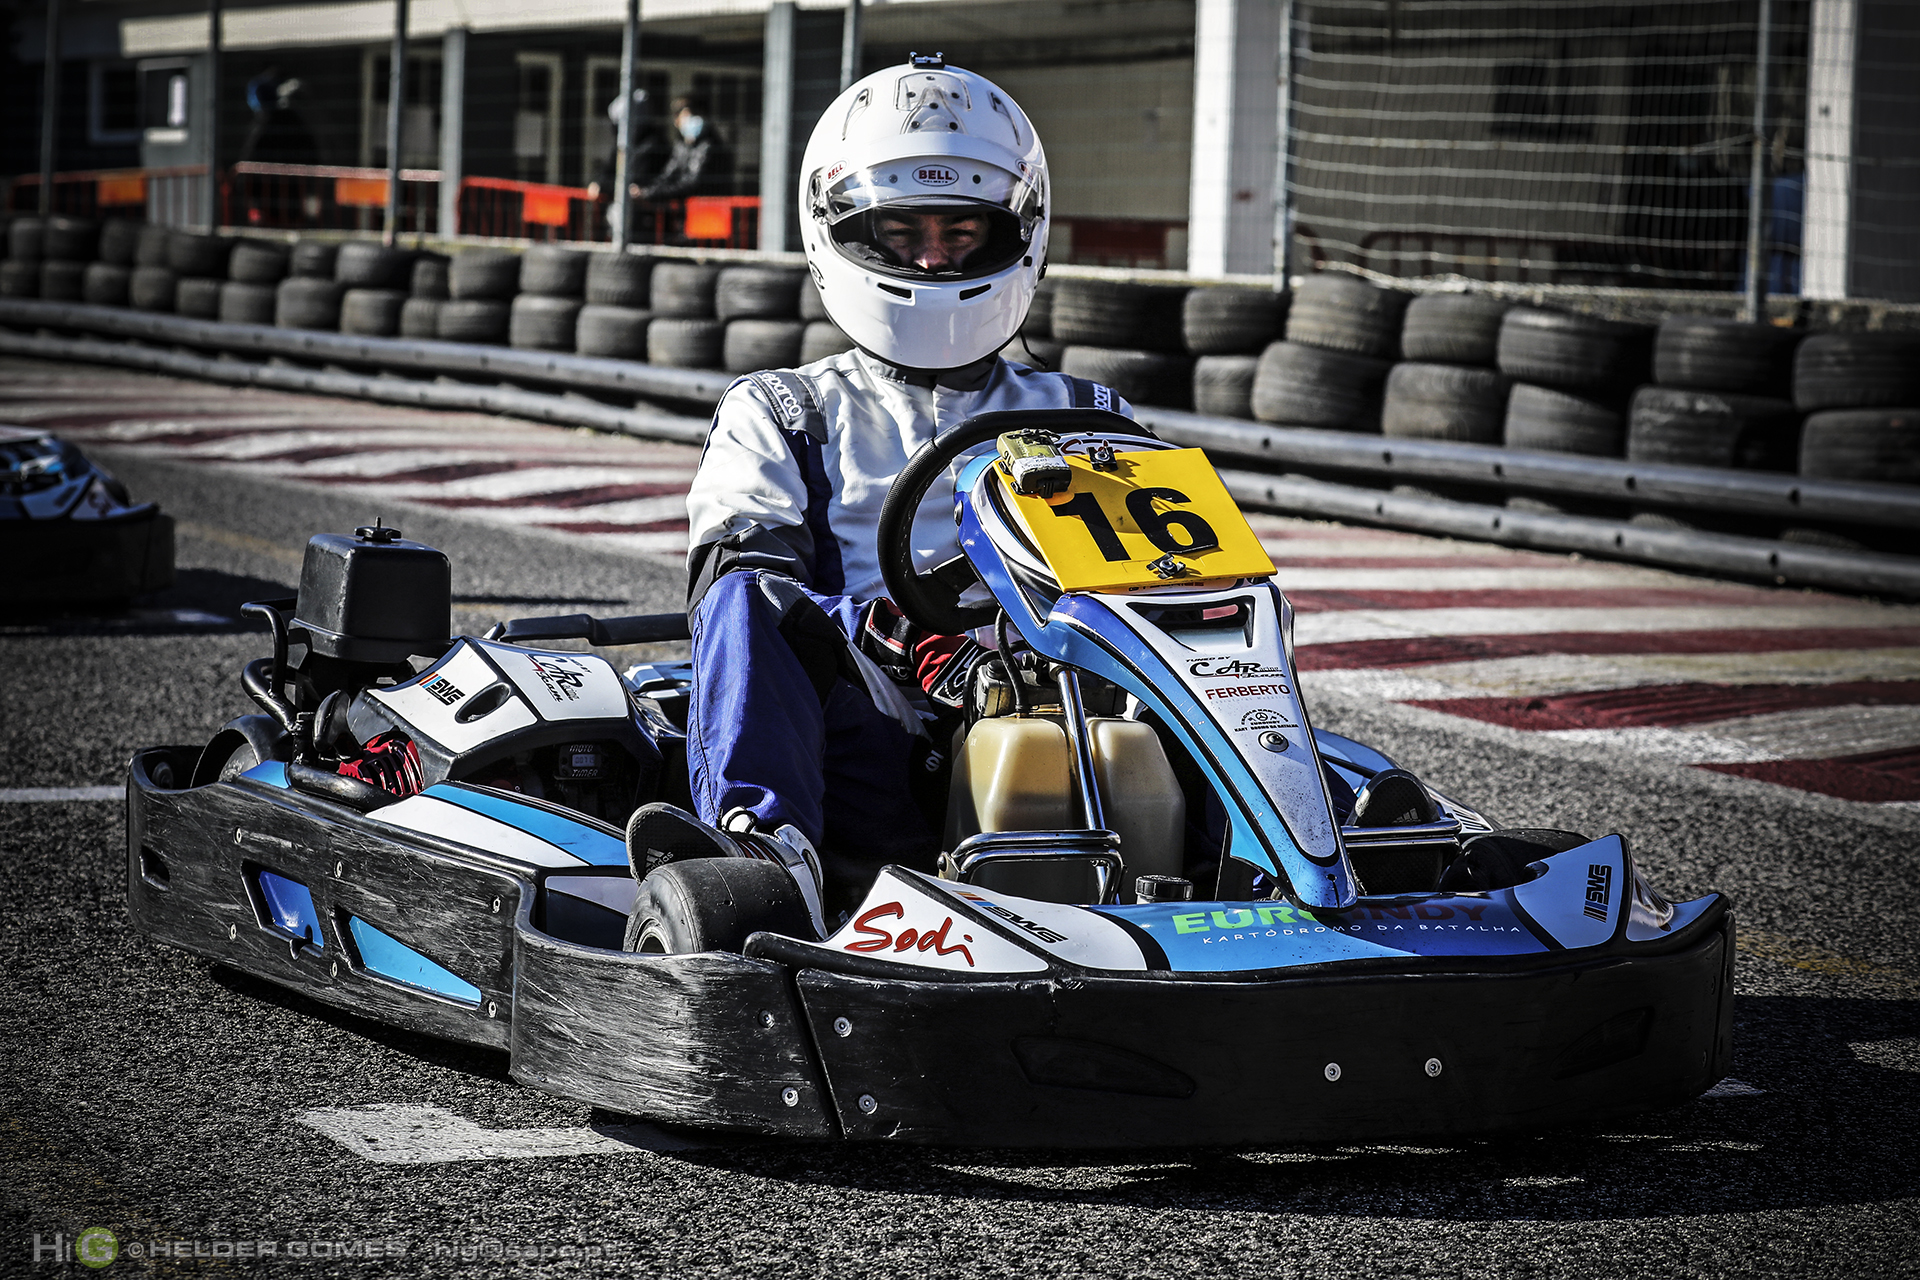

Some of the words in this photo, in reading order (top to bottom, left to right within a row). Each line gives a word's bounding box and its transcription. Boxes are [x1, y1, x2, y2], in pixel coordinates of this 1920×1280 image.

[828, 164, 844, 180] BELL
[918, 169, 953, 180] BELL
[1050, 487, 1220, 563] 16
[1205, 684, 1291, 700] FERBERTO
[571, 769, 599, 777] TIMER
[844, 901, 975, 967] Sodi
[1419, 924, 1521, 932] BATALHA
